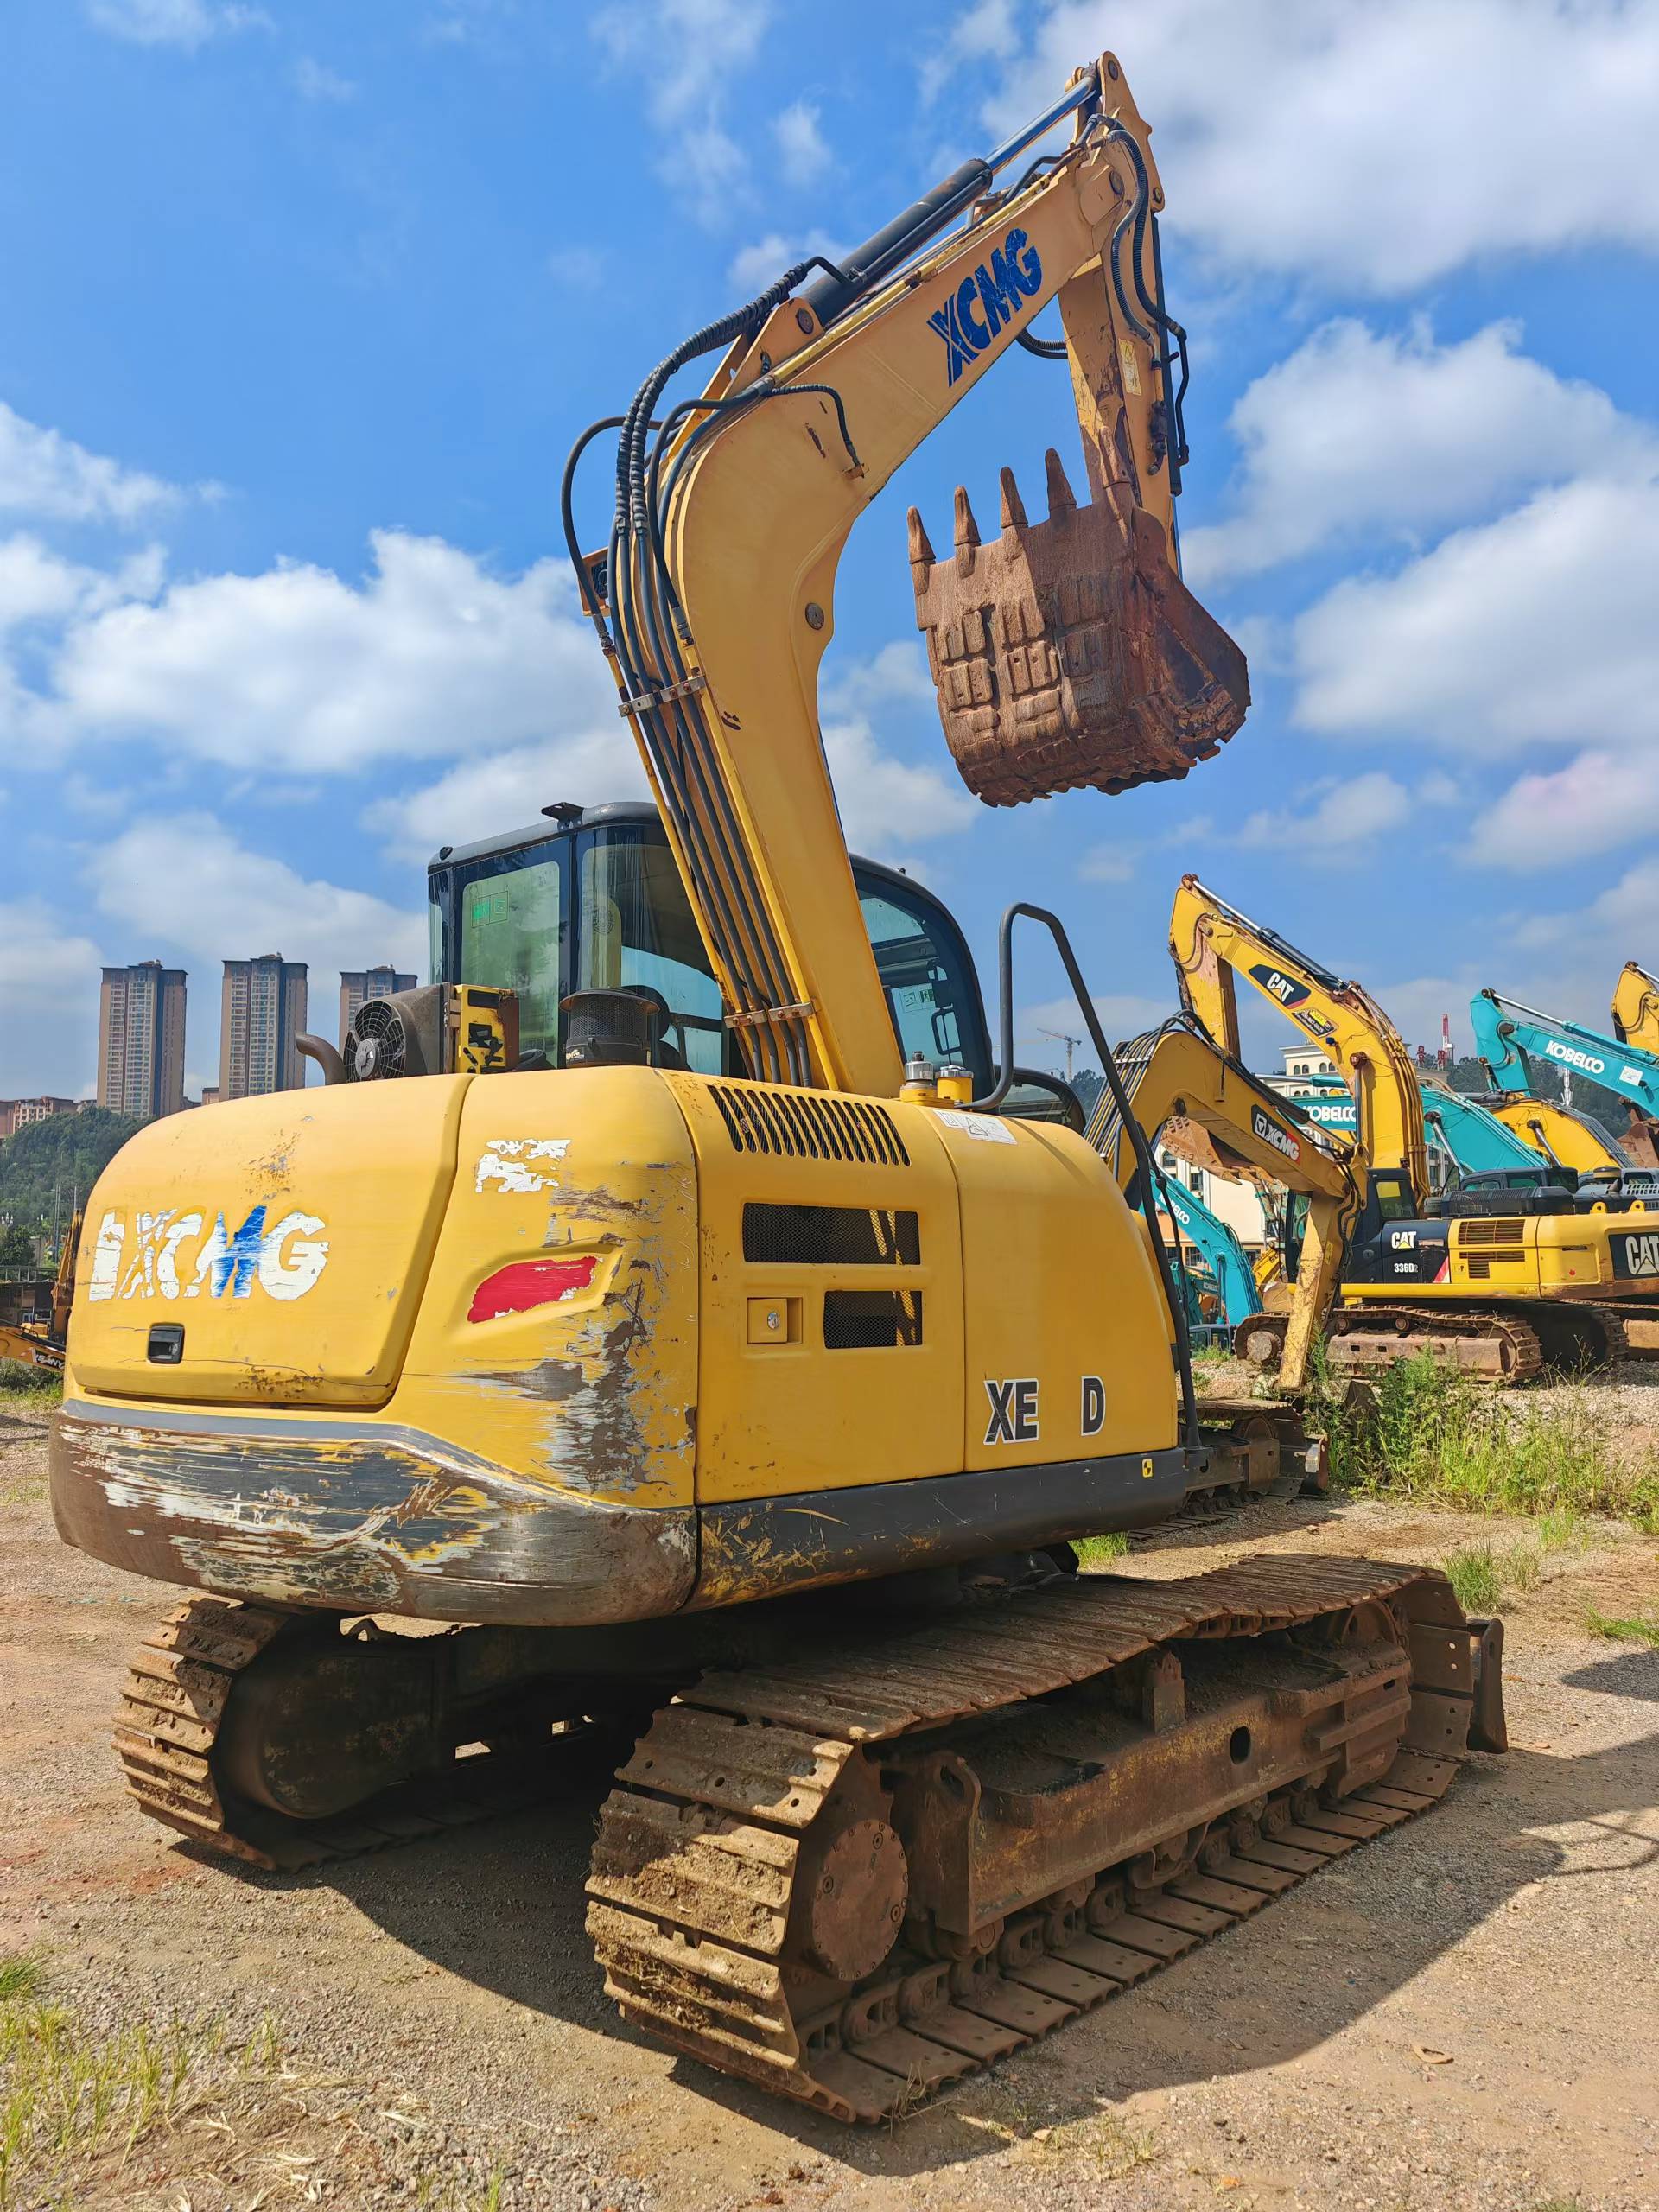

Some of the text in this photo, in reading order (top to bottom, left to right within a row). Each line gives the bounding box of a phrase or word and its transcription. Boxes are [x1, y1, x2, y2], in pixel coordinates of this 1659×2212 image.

[926, 228, 1042, 387] XCMG
[1267, 972, 1294, 1002] CAT
[1545, 1040, 1605, 1074] KOBELCO
[1264, 1123, 1300, 1160] XCMG
[1159, 1193, 1190, 1224] BELCO
[1391, 1231, 1417, 1249] CAT
[1625, 1236, 1659, 1275] CAT
[983, 1376, 1106, 1445] XE D
